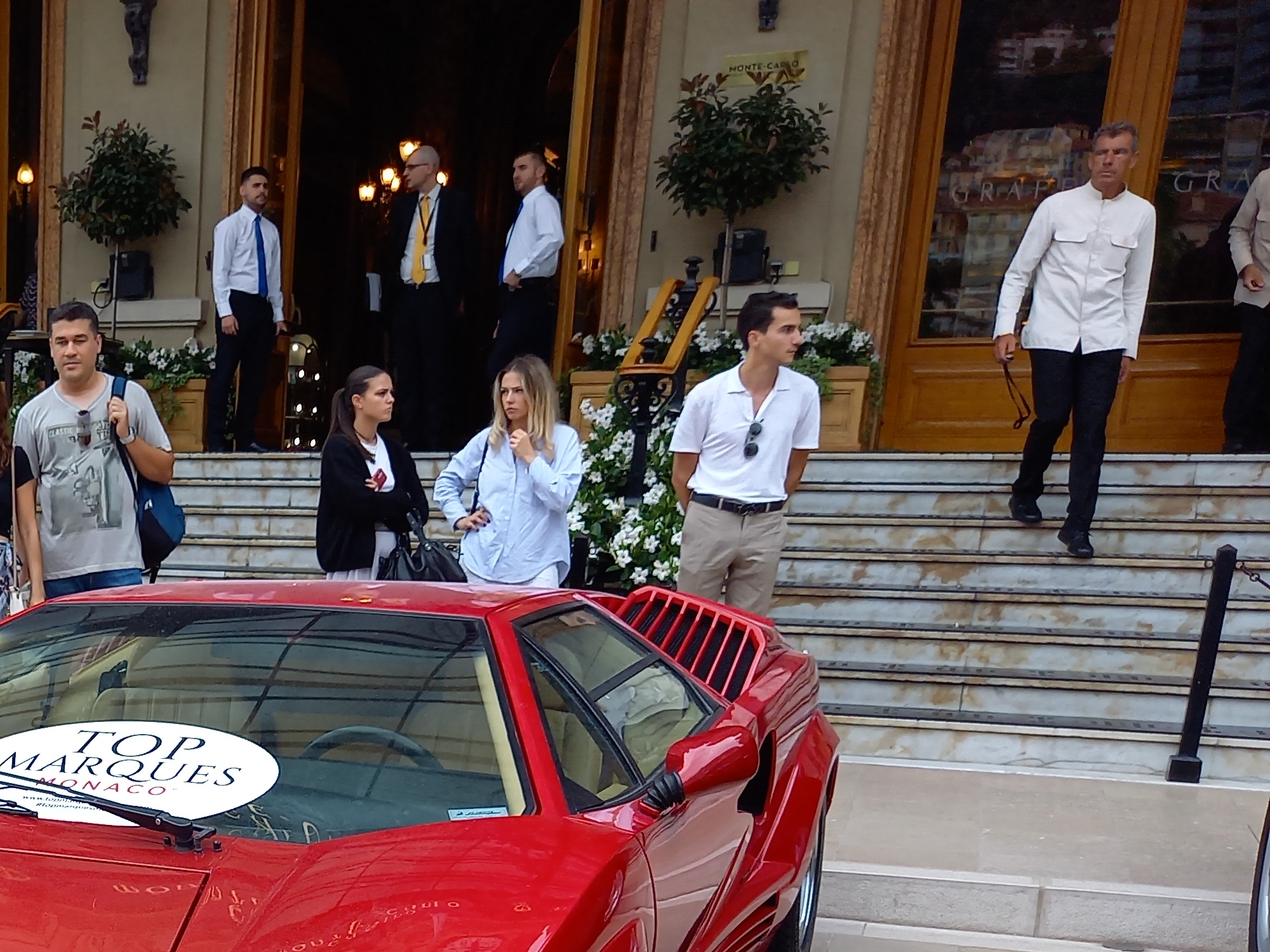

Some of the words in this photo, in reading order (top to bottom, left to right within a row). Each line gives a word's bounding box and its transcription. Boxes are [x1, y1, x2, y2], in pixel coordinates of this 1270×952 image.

[1174, 168, 1251, 193] GRA
[73, 730, 206, 760] TOP
[35, 777, 167, 796] MONACO
